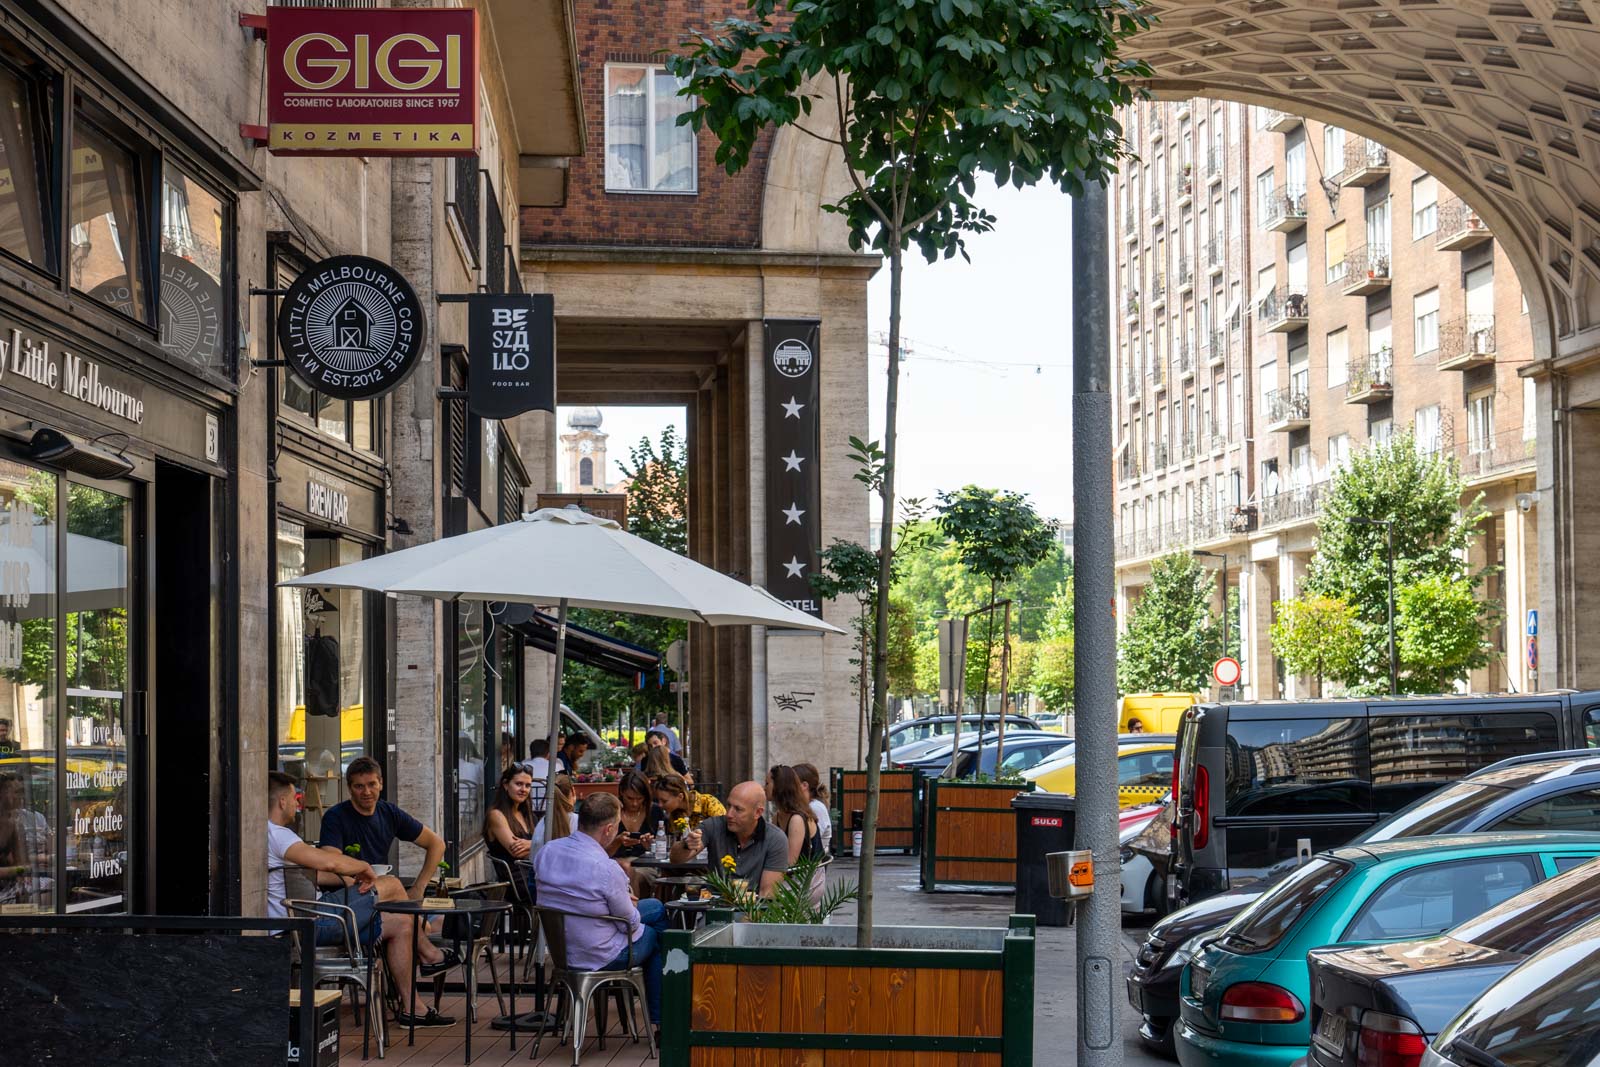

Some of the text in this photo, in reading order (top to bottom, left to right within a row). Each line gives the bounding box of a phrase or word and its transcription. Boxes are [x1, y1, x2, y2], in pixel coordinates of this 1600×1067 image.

[283, 33, 461, 90] GIGI
[284, 98, 460, 108] COSMETIC LABORATORIES SINCE 1957
[283, 131, 461, 142] KOZMETIKA
[289, 266, 413, 374] MY LITTLE MELBOURNE COFFEE
[491, 308, 529, 328] BE
[0, 328, 144, 425] y Little Melbourne
[321, 368, 384, 388] EST.2012
[208, 428, 215, 456] 3
[309, 481, 349, 526] BREW BAR
[785, 599, 819, 611] OTEL
[113, 722, 123, 743] to
[93, 761, 123, 788] coffee
[74, 805, 123, 835] for coffee
[1033, 817, 1059, 827] SULO
[89, 852, 123, 879] lovers.
